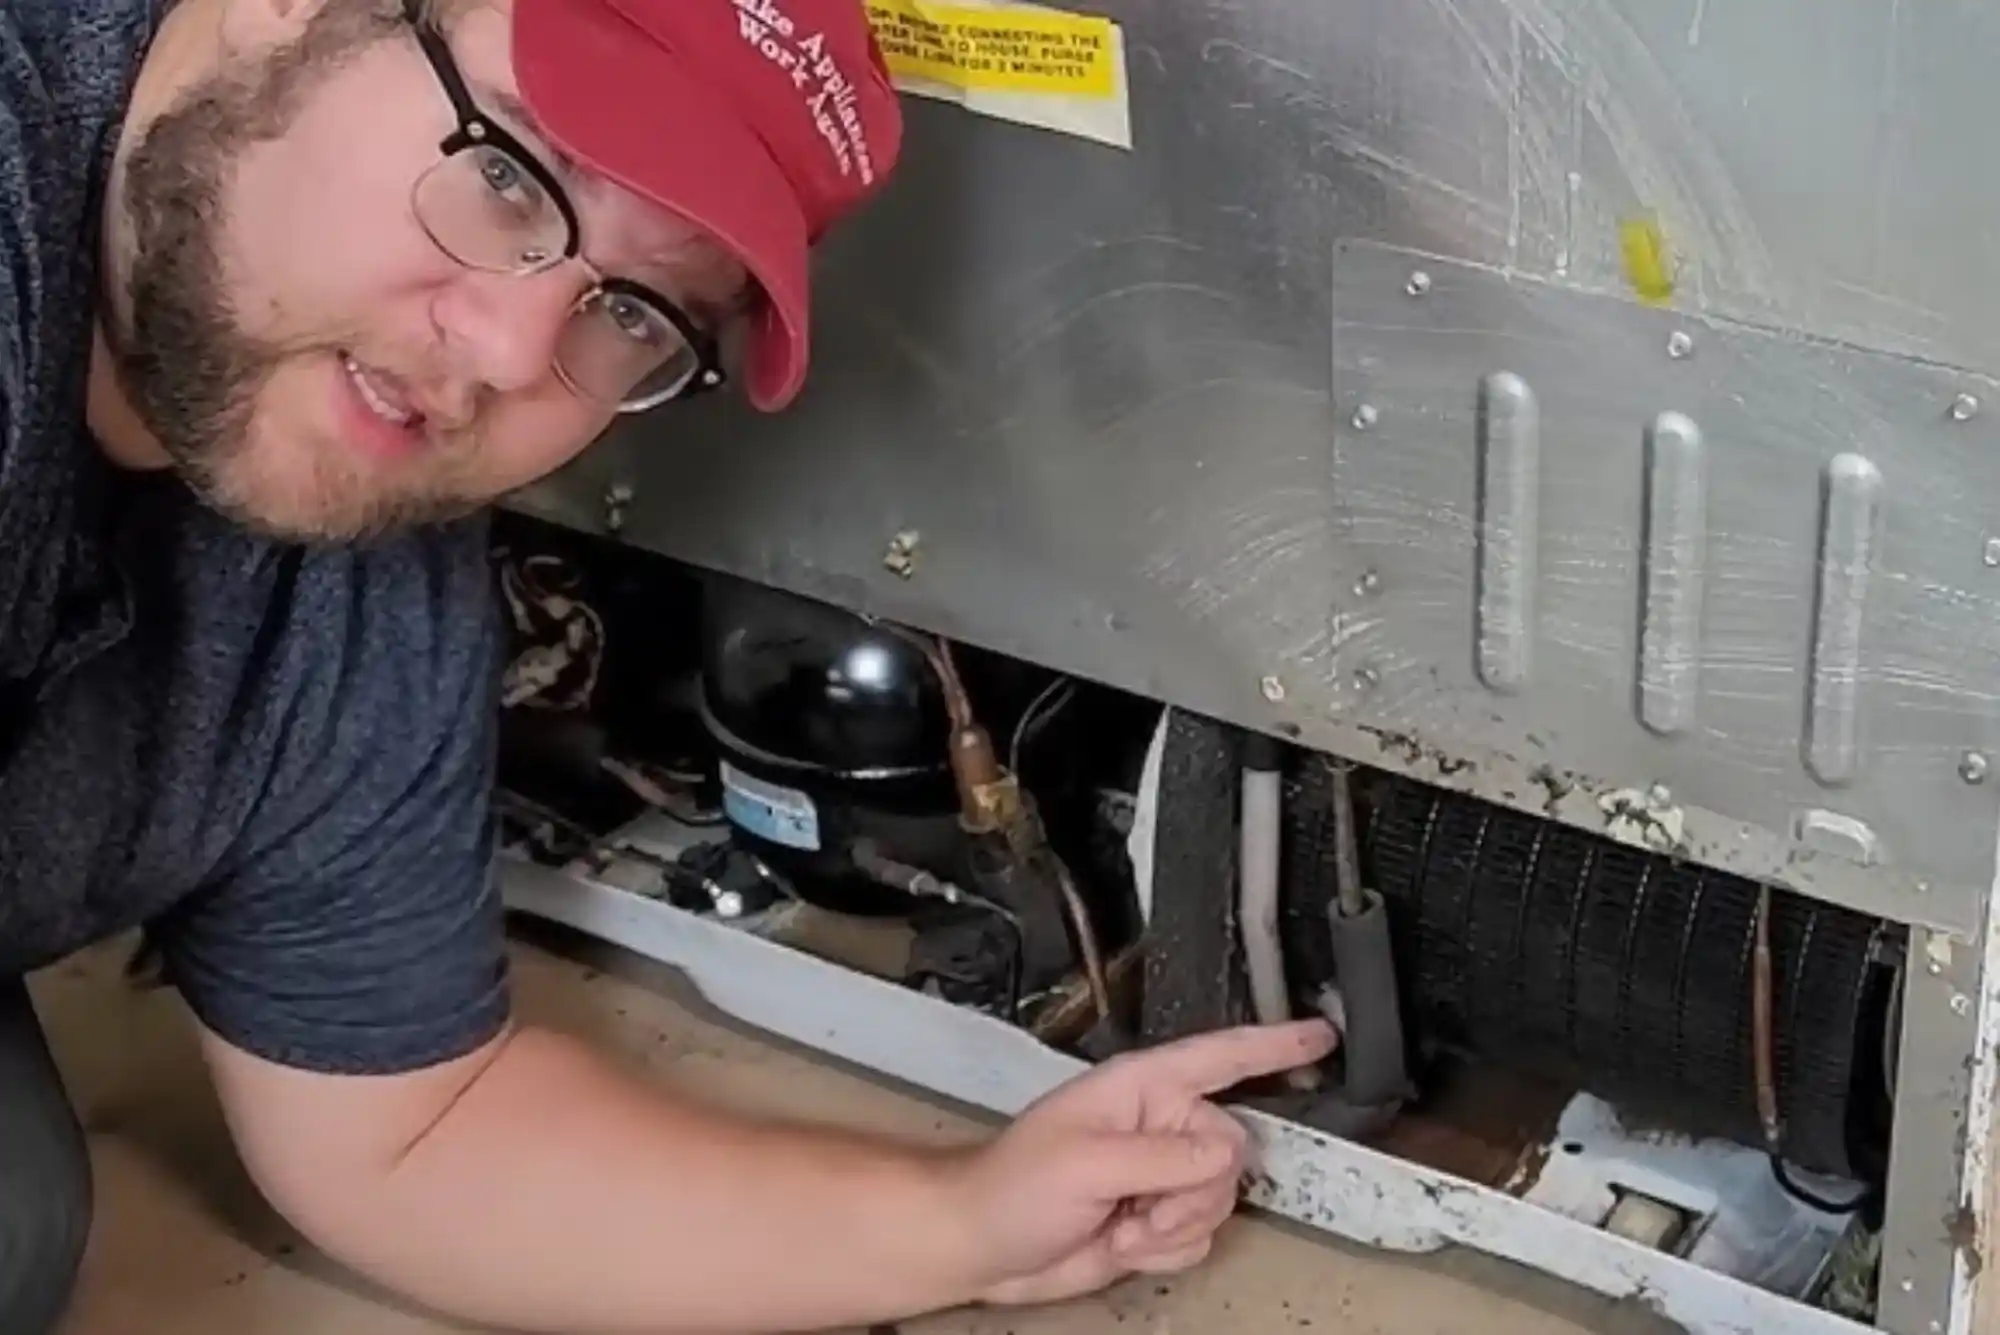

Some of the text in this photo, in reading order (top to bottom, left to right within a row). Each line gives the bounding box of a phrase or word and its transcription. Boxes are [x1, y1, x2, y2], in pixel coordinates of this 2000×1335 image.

[947, 38, 970, 53] TO
[958, 24, 1064, 46] CONNECTING
[1072, 33, 1102, 49] THE
[958, 57, 991, 71] FOR
[1011, 61, 1085, 78] MINUTES
[731, 0, 874, 186] ake Appliances
[736, 9, 852, 176] Work Again
